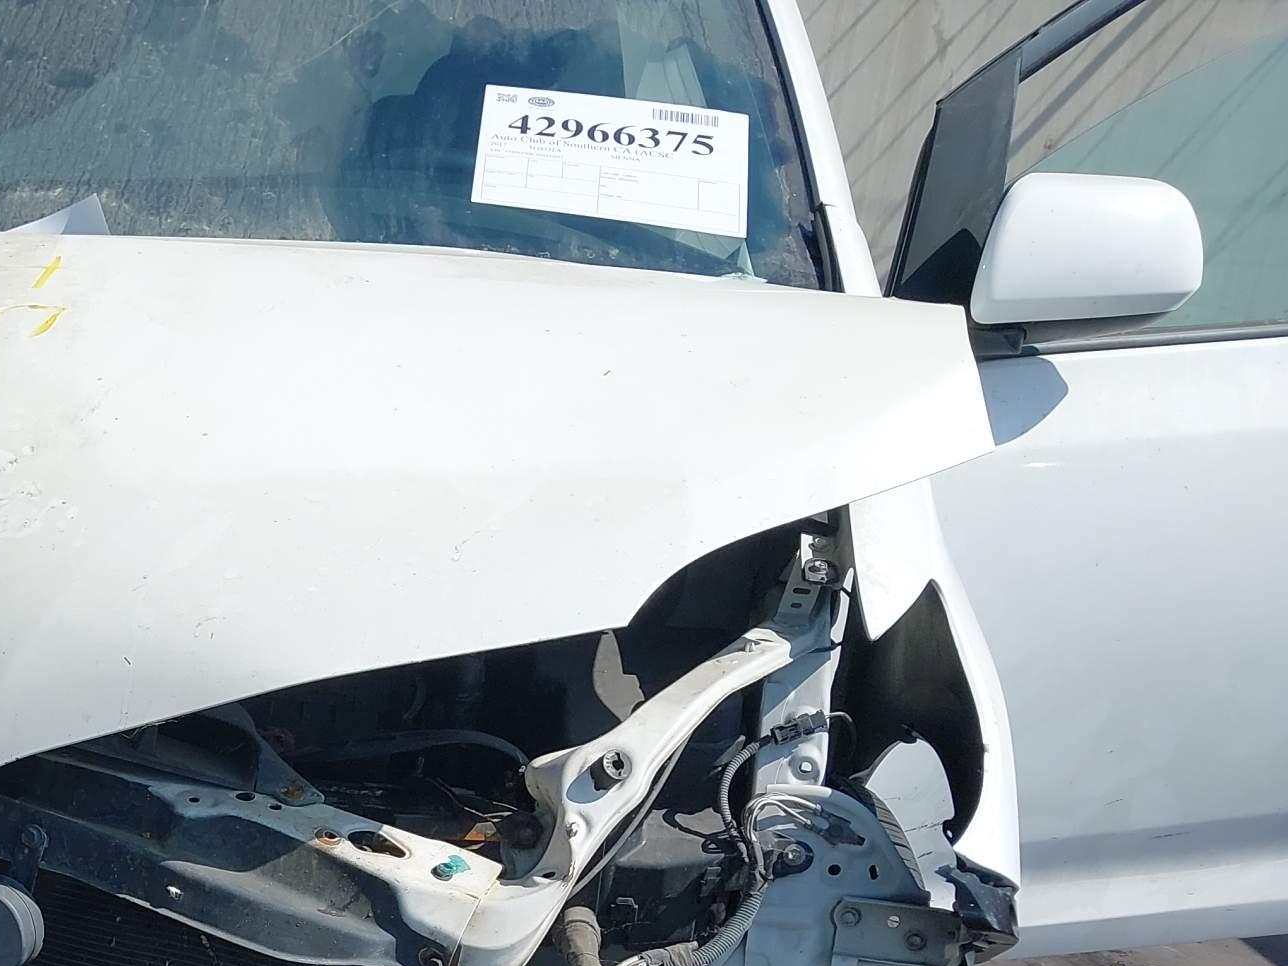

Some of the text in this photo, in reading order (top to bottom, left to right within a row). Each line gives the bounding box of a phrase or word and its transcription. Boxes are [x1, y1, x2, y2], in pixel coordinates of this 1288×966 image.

[491, 133, 518, 142] Auto
[520, 136, 546, 145] Club
[563, 140, 610, 152] Southern
[613, 146, 631, 154] CA
[508, 113, 715, 157] 42966375
